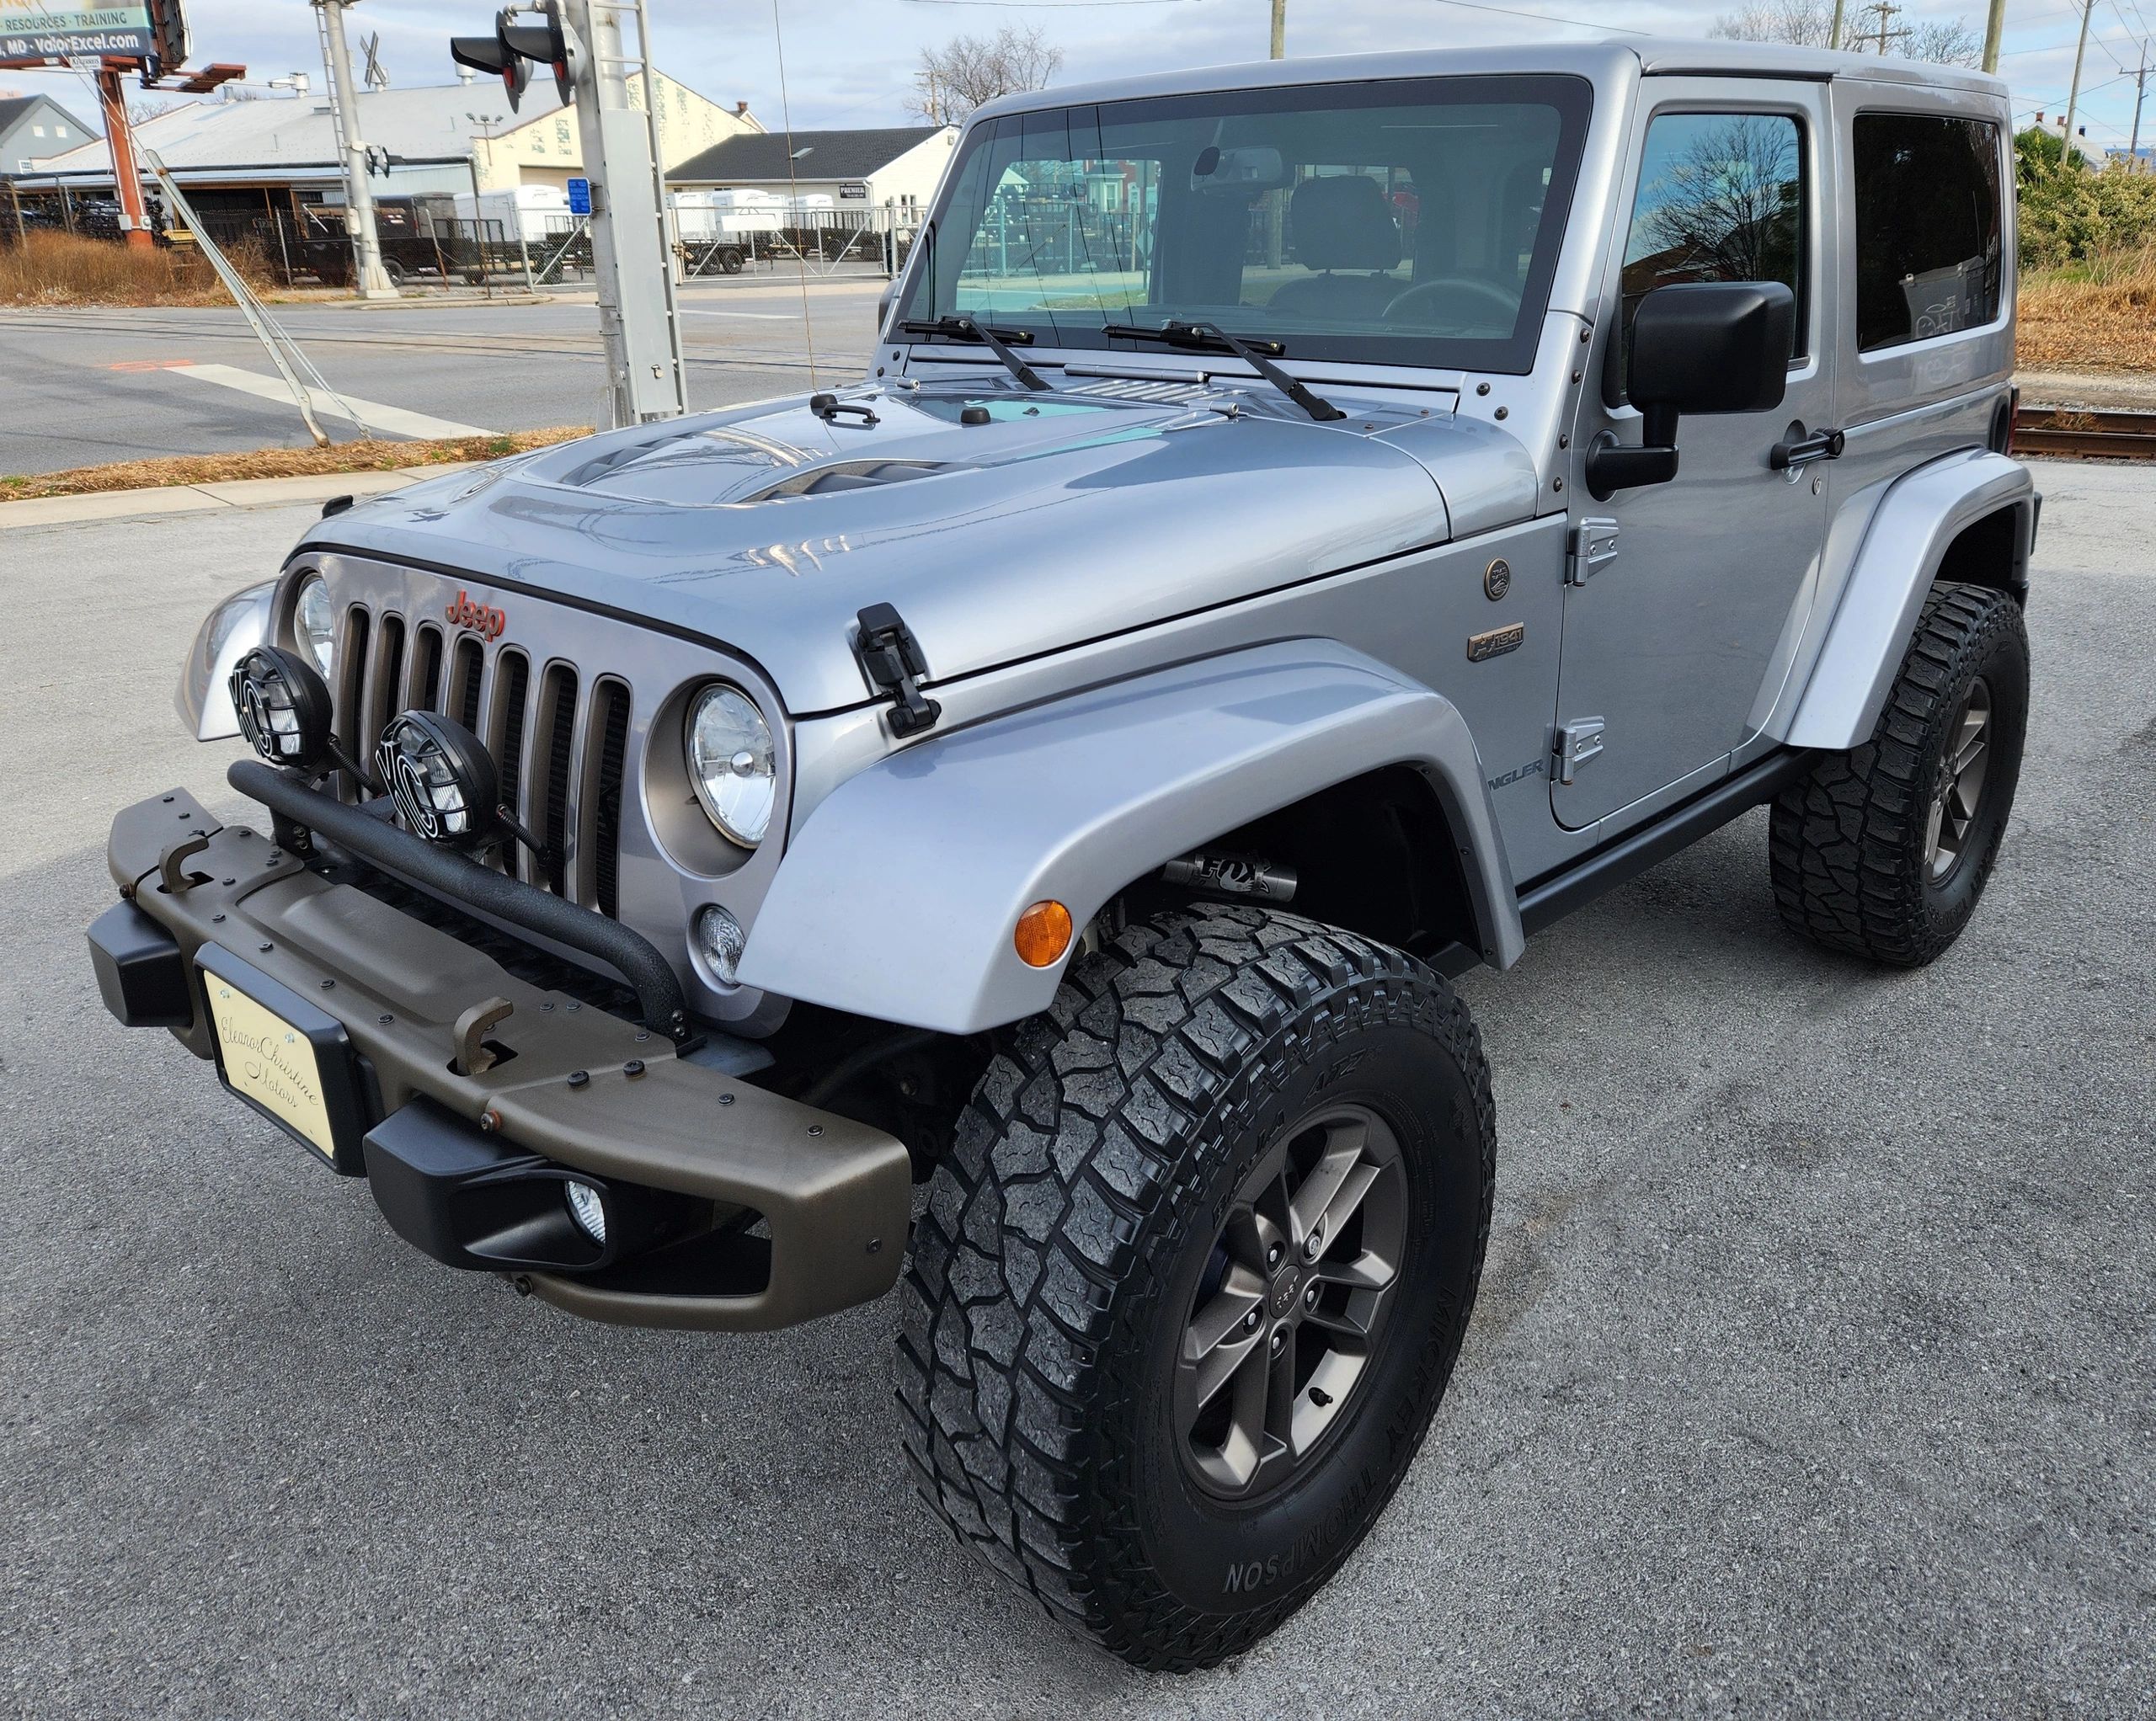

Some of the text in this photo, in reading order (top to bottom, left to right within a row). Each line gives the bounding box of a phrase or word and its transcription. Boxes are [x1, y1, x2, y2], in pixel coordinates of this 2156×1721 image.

[6, 12, 127, 31] RESOURCES TRAINING
[7, 39, 27, 55] MD
[35, 33, 139, 54] ValorExcel.com
[445, 589, 505, 642] Jeep
[1495, 629, 1522, 647] 1941
[375, 741, 439, 839] KC
[244, 1061, 297, 1108] Motors
[1221, 1466, 1380, 1596] THOMPSON
